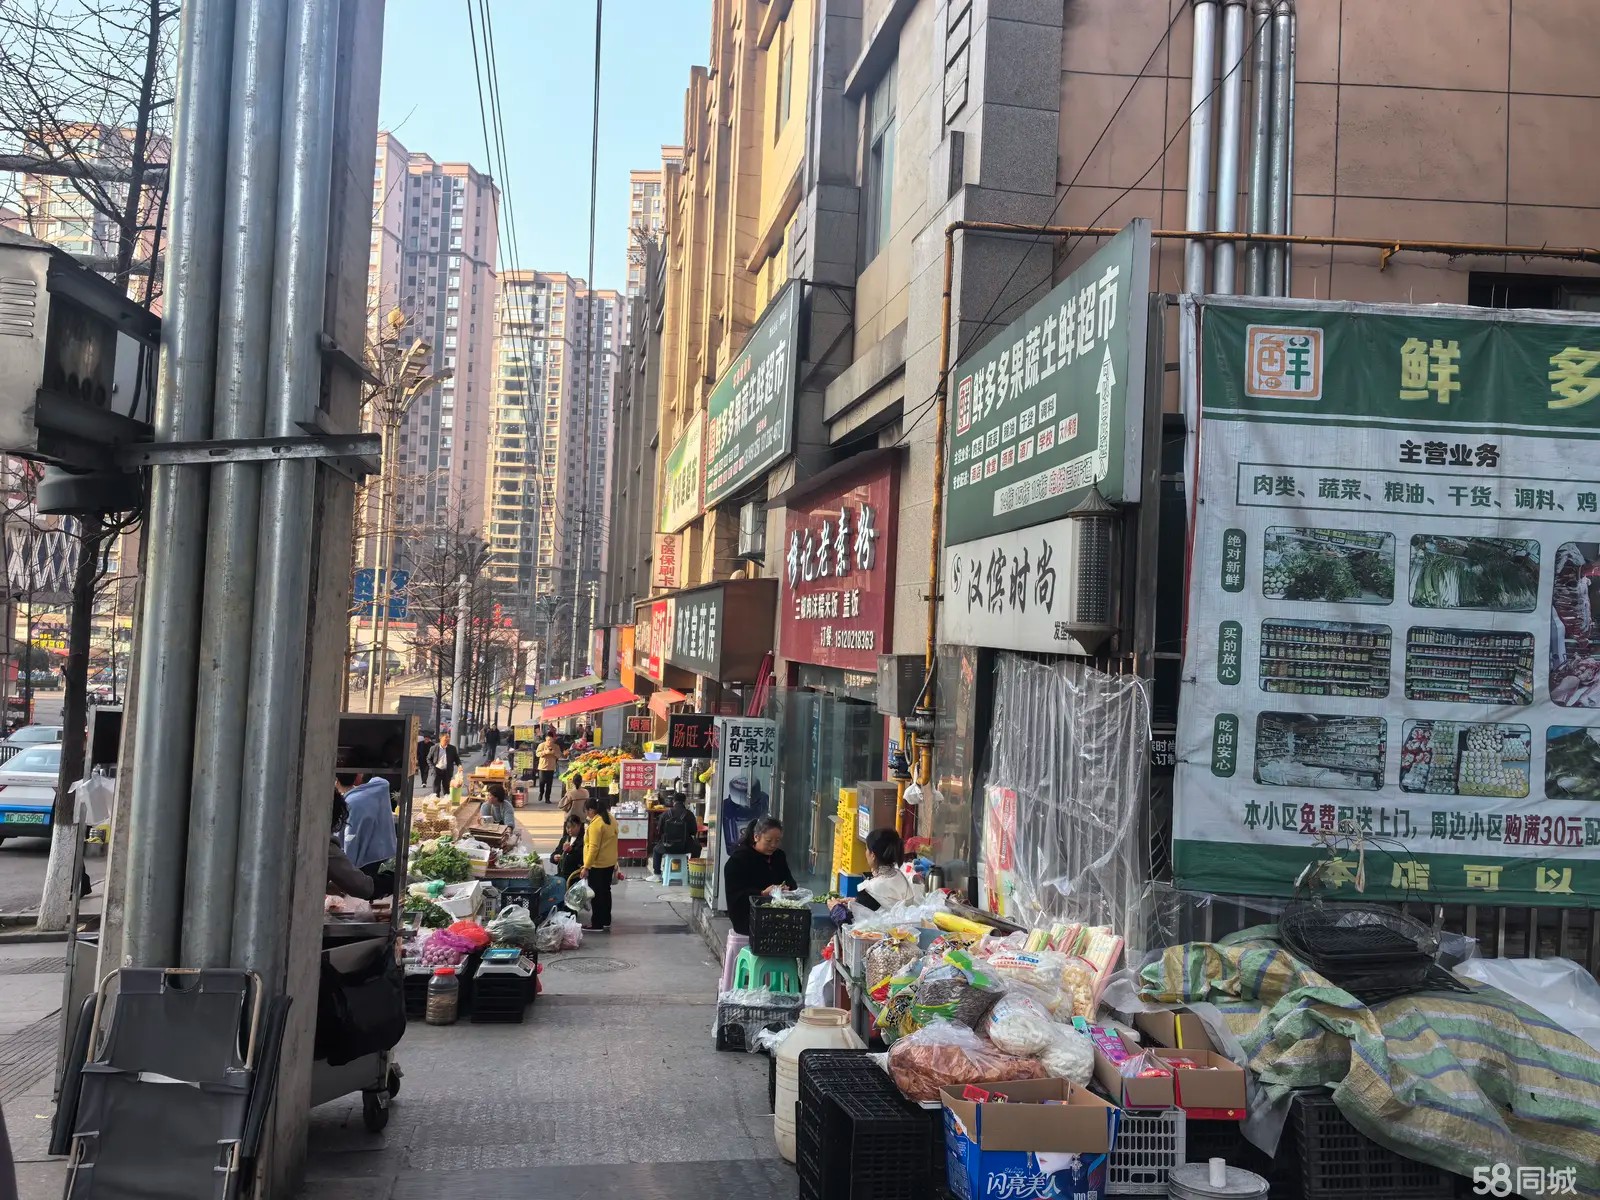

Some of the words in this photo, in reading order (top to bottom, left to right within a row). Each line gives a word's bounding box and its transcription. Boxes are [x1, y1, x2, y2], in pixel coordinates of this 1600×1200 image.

[972, 265, 1120, 425] 鲜多多果蔬生鲜超市
[1021, 411, 1033, 430] 干货
[1399, 440, 1501, 468] 主营业务
[659, 544, 675, 586] 医保刷卡
[1225, 535, 1242, 586] 绝对新鲜
[843, 588, 859, 618] 盖饭
[1222, 627, 1238, 678] 买的放心
[672, 723, 699, 748] 肠旺
[729, 738, 774, 753] 矿泉水
[730, 726, 776, 738] 真正天然
[1216, 720, 1233, 771] 吃的安心
[729, 754, 773, 768] 百岁山
[1151, 754, 1176, 766] 订制
[986, 1171, 1061, 1199] 闪亮美人
